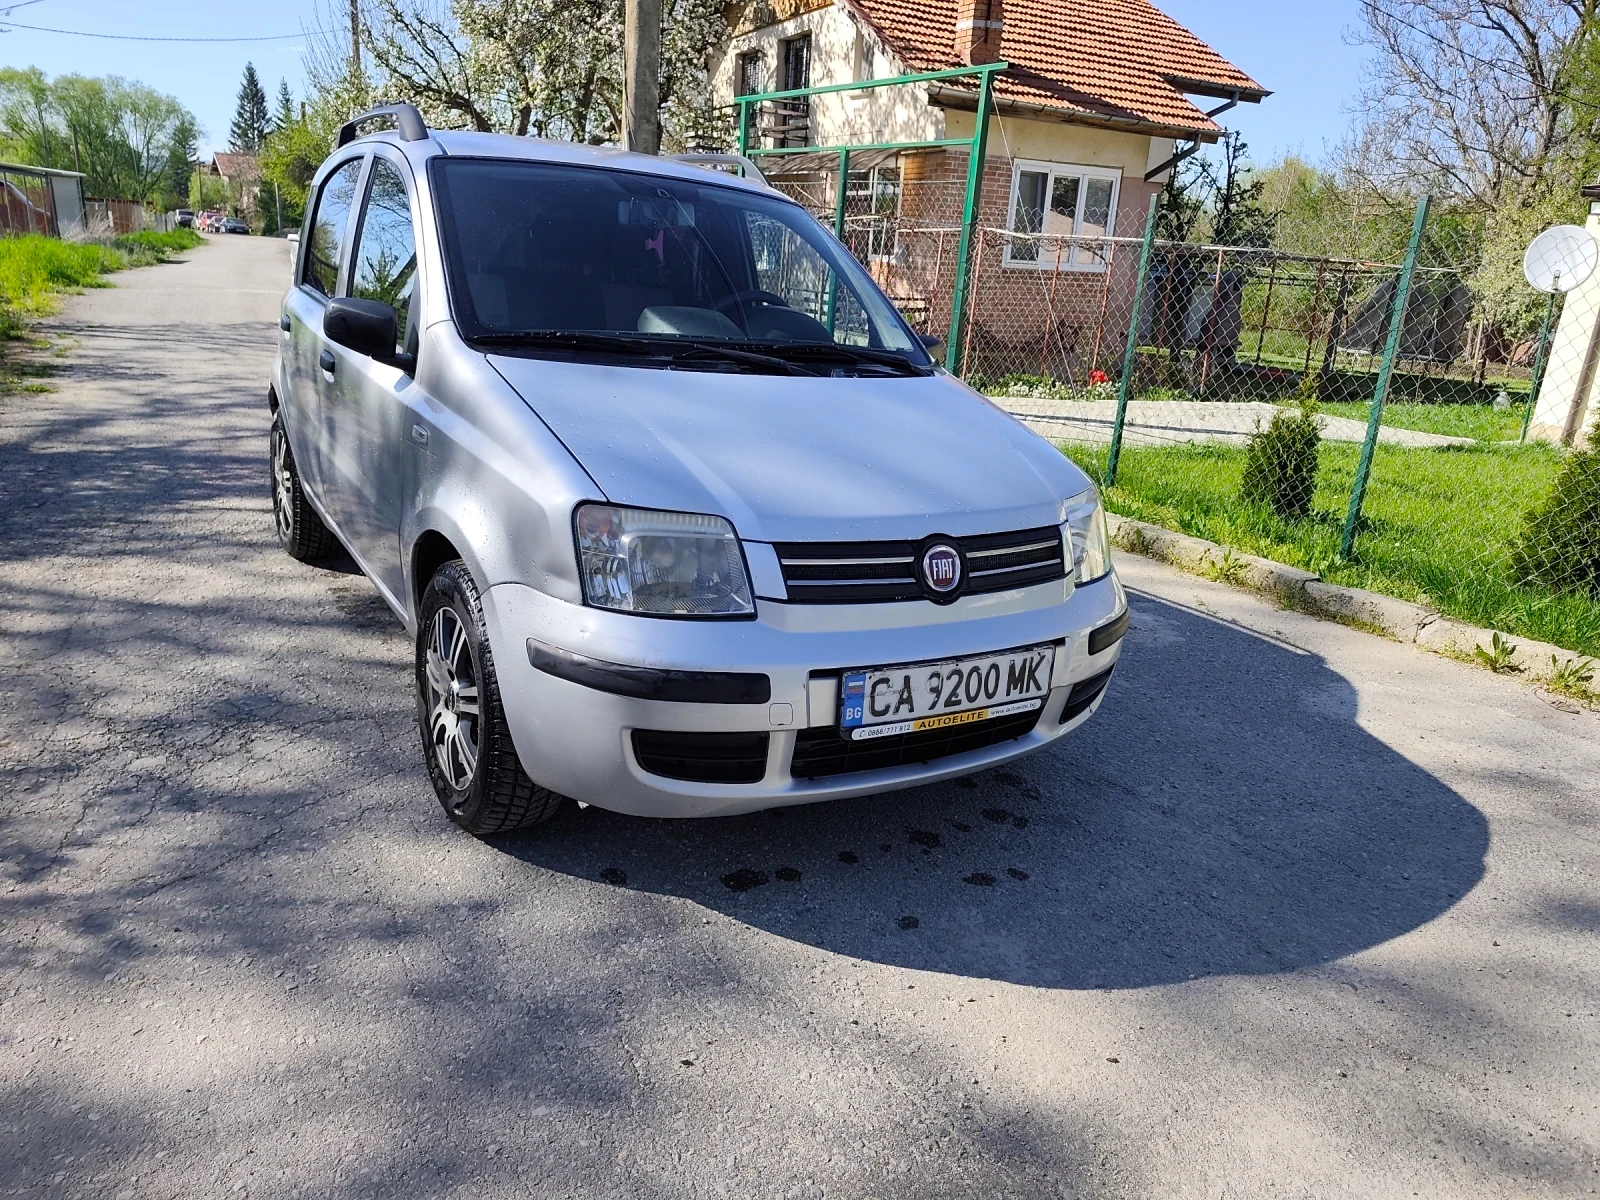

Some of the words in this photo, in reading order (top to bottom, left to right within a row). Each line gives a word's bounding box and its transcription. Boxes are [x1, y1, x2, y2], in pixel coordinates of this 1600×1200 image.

[932, 558, 953, 580] FIAT
[926, 662, 1001, 711] 9200
[846, 707, 862, 720] BG
[918, 711, 985, 729] AUTOELITE
[899, 724, 911, 732] 812
